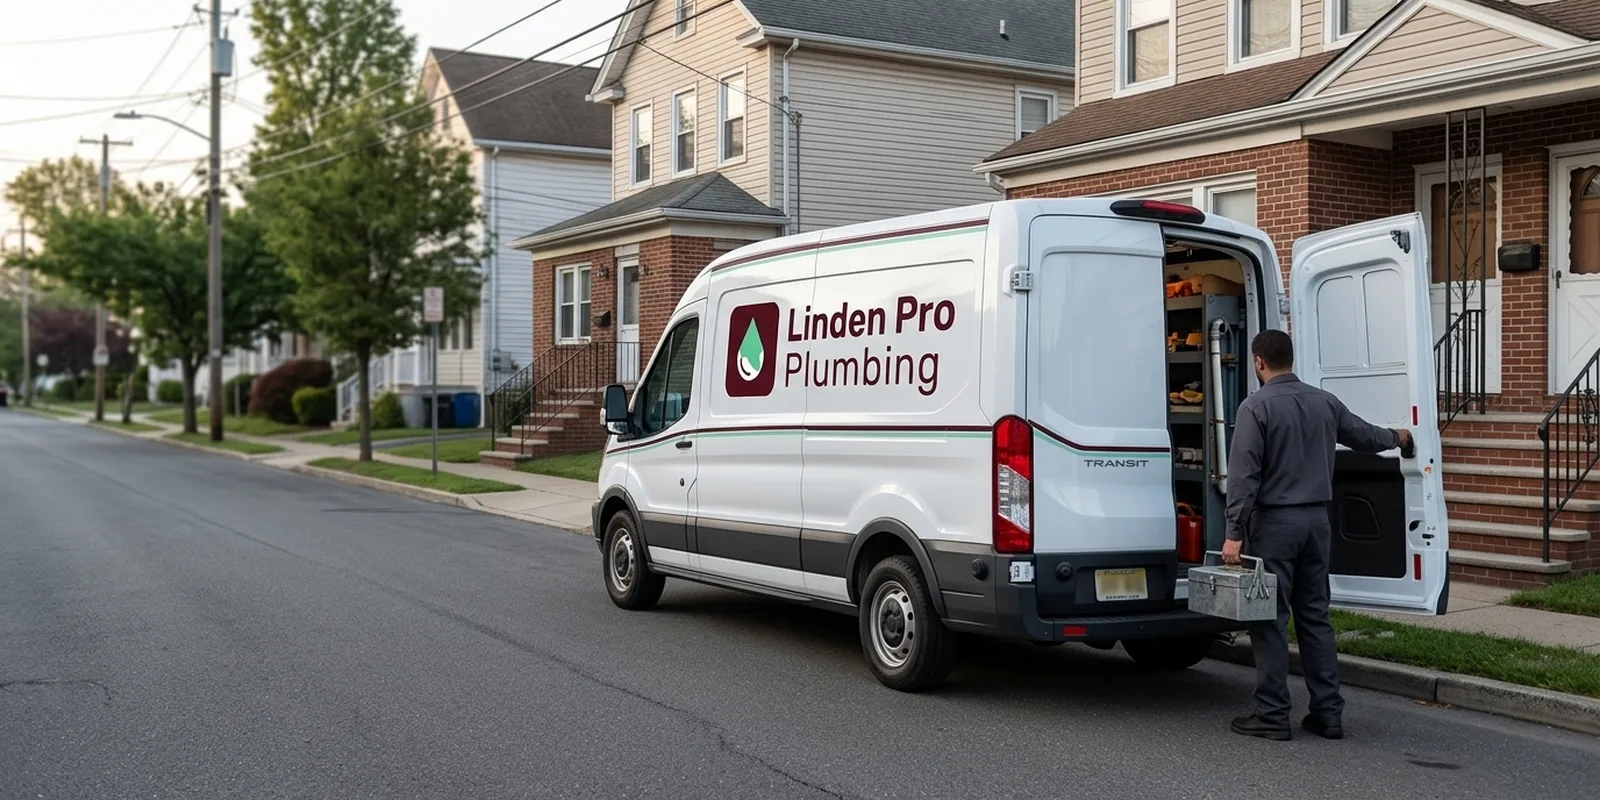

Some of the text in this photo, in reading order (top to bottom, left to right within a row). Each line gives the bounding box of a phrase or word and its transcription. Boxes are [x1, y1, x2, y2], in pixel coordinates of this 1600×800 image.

[788, 296, 956, 342] Linden Pro
[785, 346, 939, 396] Plumbing
[1084, 459, 1149, 468] TRANSIT
